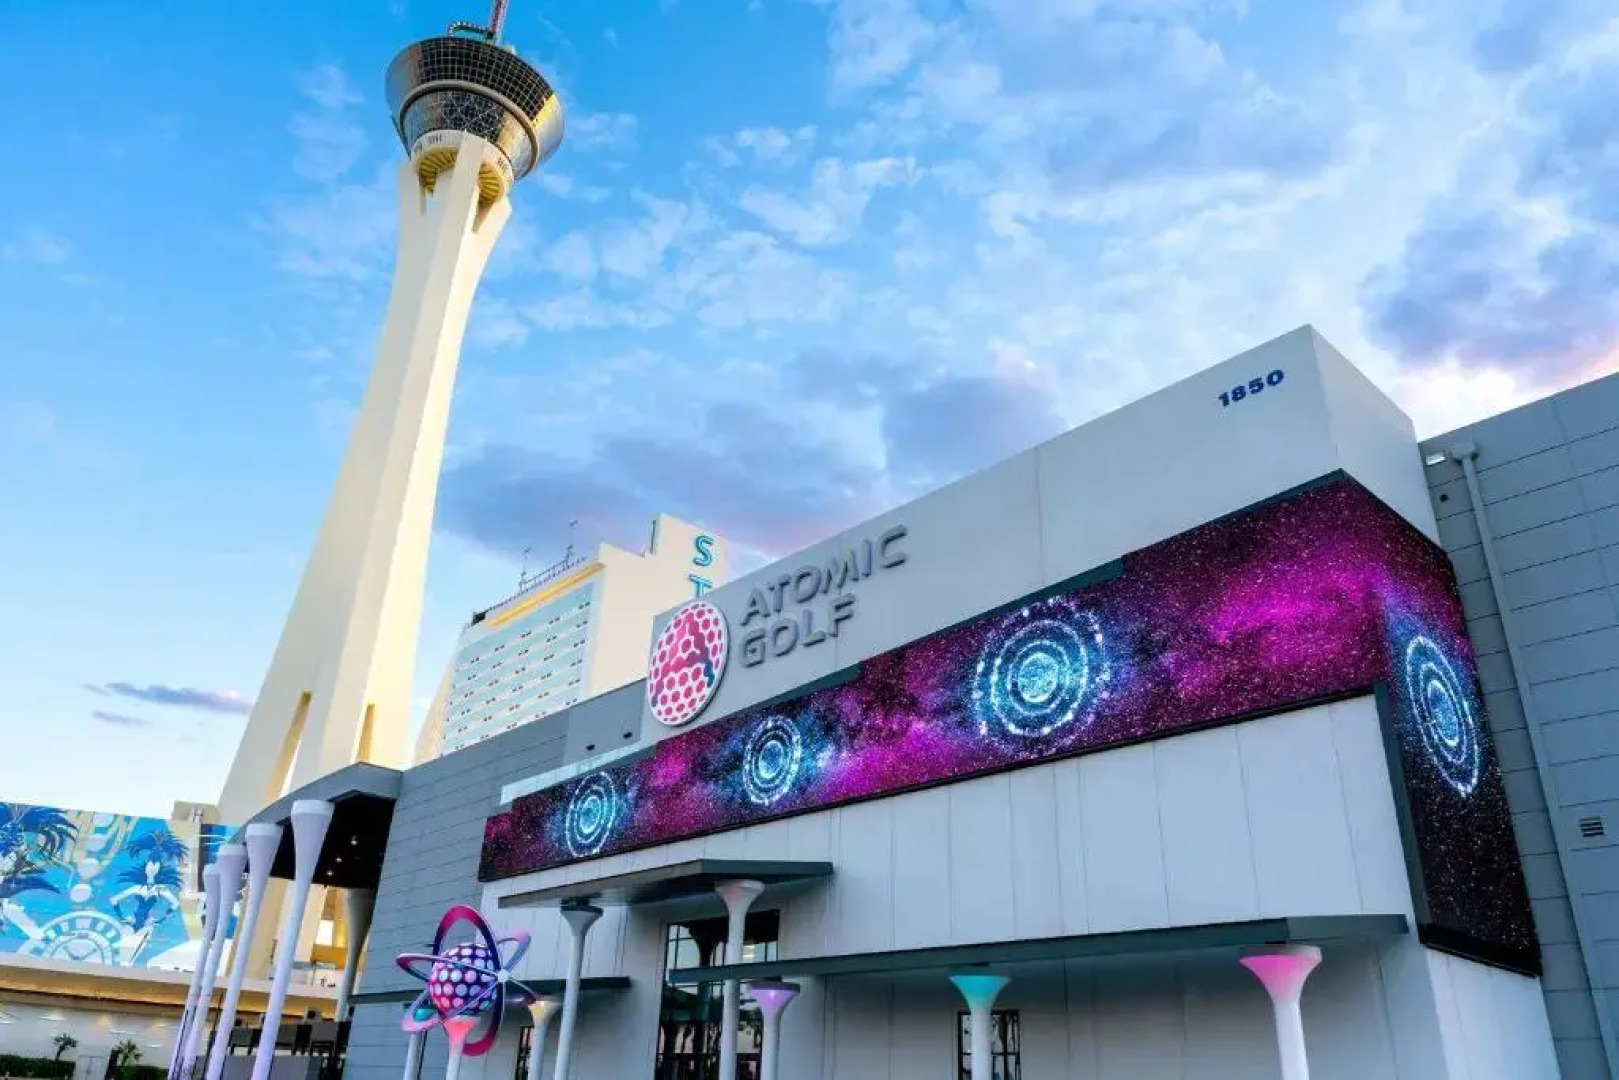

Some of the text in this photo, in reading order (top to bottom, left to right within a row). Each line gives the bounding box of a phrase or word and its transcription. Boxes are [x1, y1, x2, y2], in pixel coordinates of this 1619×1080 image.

[1218, 369, 1284, 407] 1850
[740, 525, 908, 626] ATOMIC
[742, 593, 856, 668] GOLF
